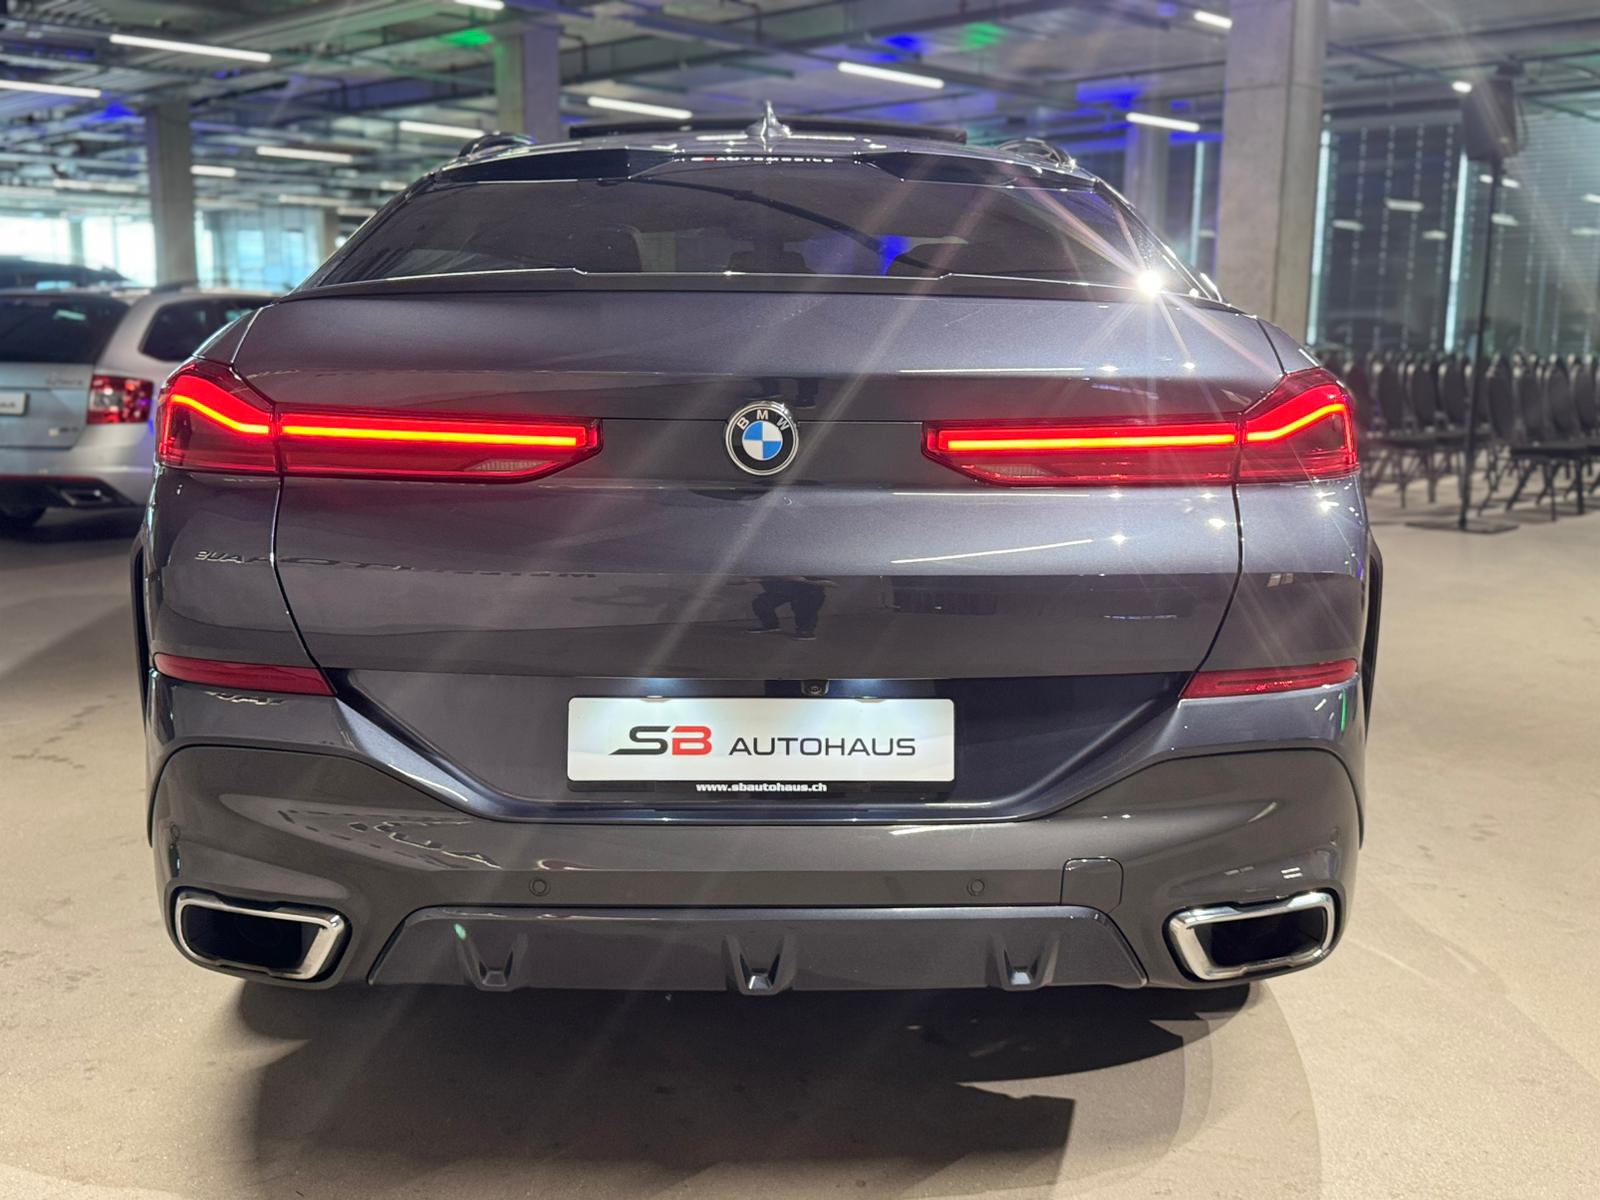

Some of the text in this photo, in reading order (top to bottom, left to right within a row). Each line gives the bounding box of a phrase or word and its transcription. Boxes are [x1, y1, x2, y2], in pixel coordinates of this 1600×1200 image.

[736, 409, 790, 431] BMW
[608, 725, 916, 757] SB AUTOHAUS
[695, 782, 828, 793] www.sbautohaus.ch
